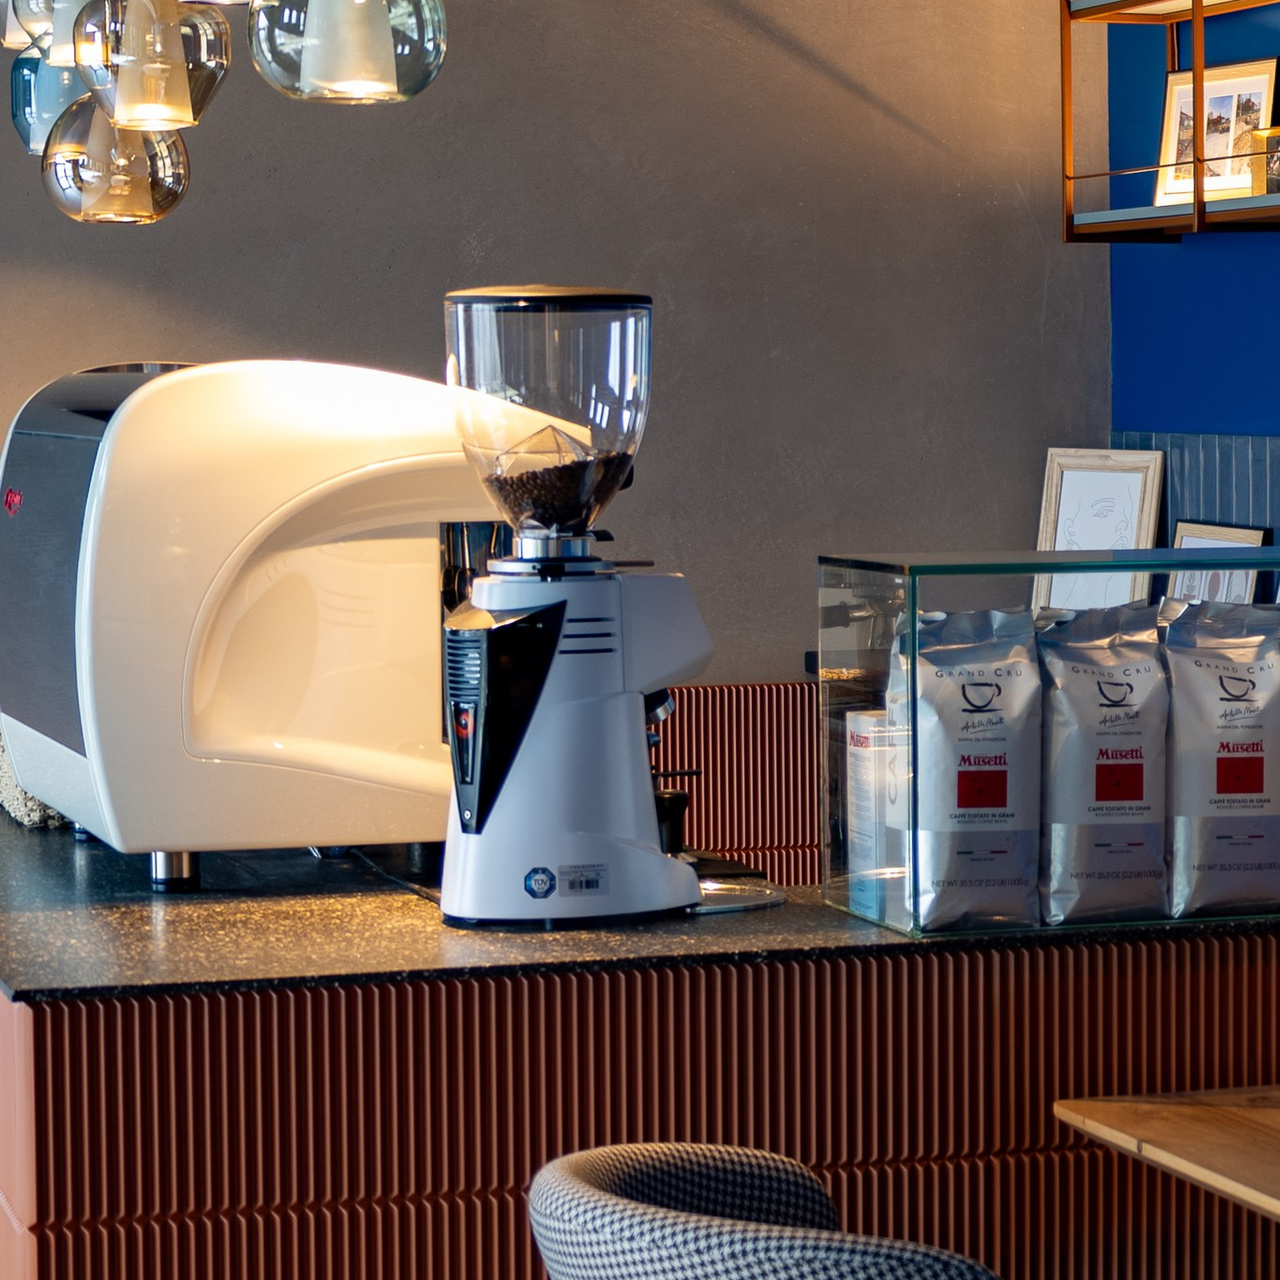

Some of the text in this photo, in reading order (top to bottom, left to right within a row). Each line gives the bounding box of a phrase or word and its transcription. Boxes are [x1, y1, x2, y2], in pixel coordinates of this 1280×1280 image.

[1072, 666, 1151, 678] GRAND CRU
[1194, 660, 1274, 674] GRAND CRU
[935, 668, 1022, 678] GRAND CRU
[1217, 739, 1265, 753] Musetti
[1096, 745, 1144, 760] Musetti
[958, 752, 1008, 766] Musetti
[966, 812, 990, 820] TOSTATO
[998, 812, 1016, 820] GRANI
[1192, 862, 1206, 872] NET
[1207, 862, 1218, 872] WT
[1233, 862, 1243, 872] OZ
[1070, 870, 1084, 880] NET
[1085, 870, 1097, 880] WT
[1110, 870, 1121, 880] OZ
[932, 878, 946, 888] NET
[947, 878, 958, 888] WT
[974, 878, 984, 888] OZ
